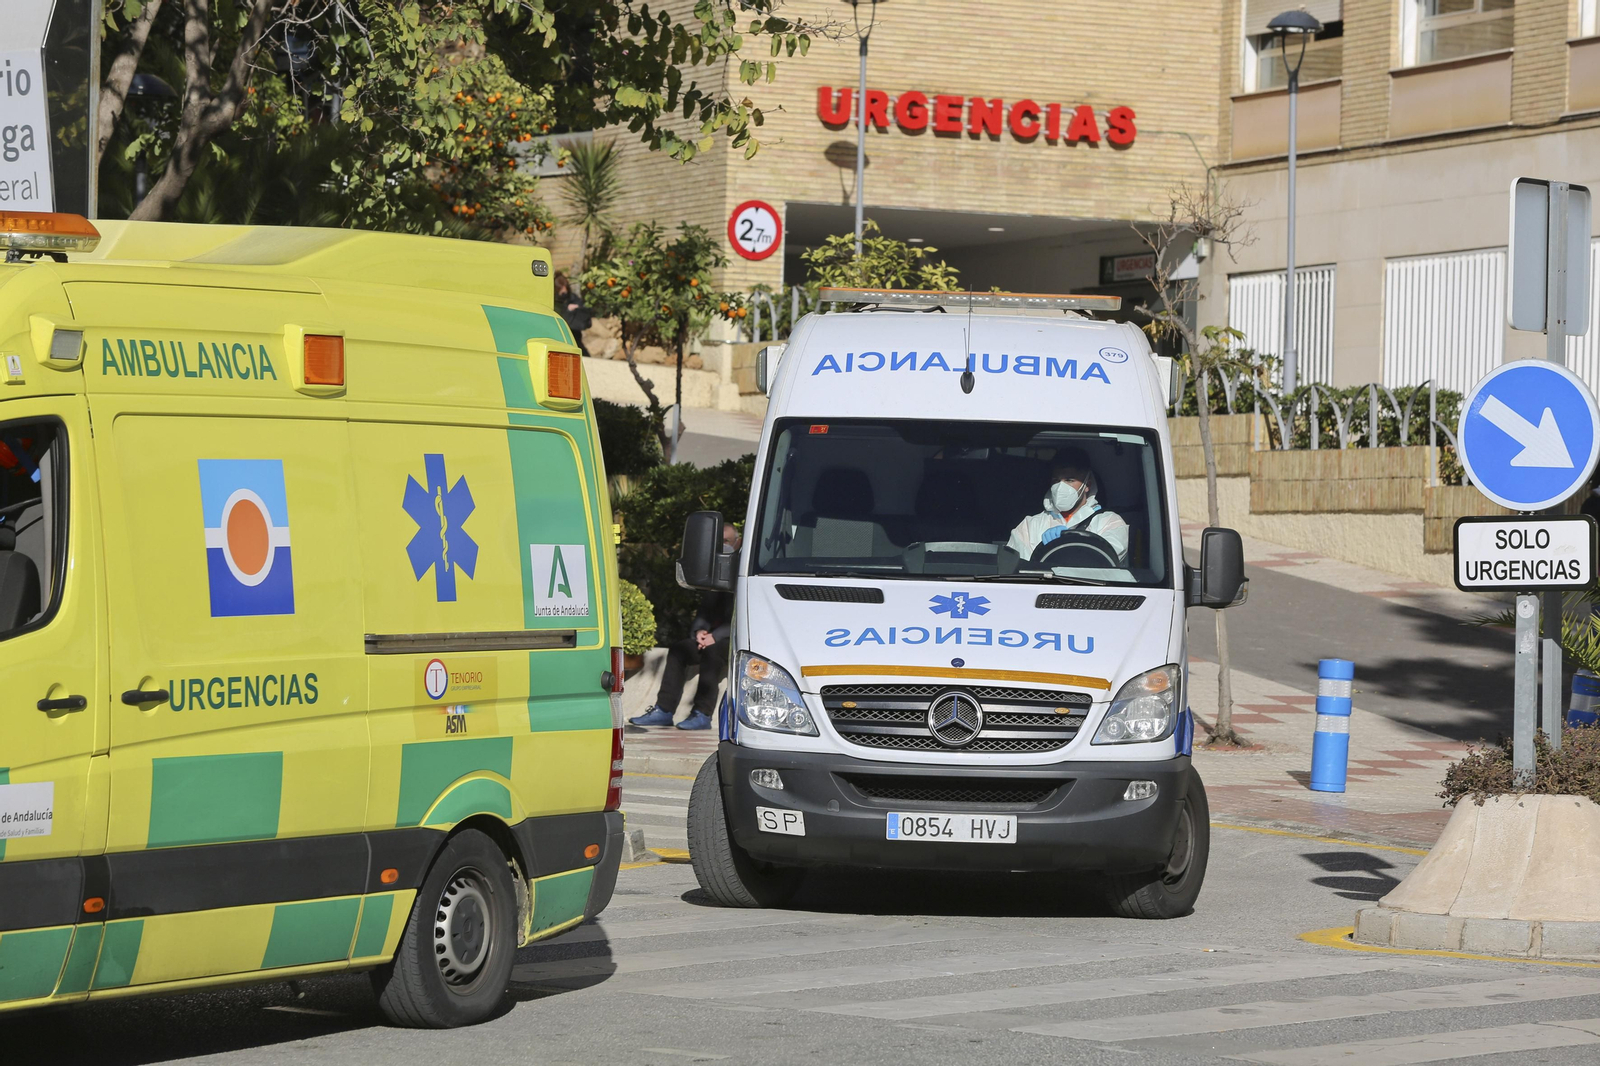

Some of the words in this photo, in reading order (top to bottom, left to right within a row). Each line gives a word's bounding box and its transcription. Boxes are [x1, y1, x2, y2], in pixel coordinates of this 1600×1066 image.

[0, 60, 31, 96] io
[817, 86, 1137, 145] URGENCIAS
[2, 124, 35, 162] ga
[0, 171, 39, 201] eral
[102, 338, 278, 381] AMBULANCIA
[1105, 351, 1124, 359] 379
[1495, 529, 1550, 550] SOLO
[1465, 559, 1581, 581] URGENCIAS
[535, 605, 552, 616] Junta
[552, 605, 560, 616] de
[560, 603, 589, 616] Andalucía
[450, 671, 483, 684] TENORIO
[169, 672, 319, 712] URGENCIAS
[445, 714, 467, 734] ASM
[1, 812, 12, 823] de
[13, 807, 53, 822] Andalucía
[902, 816, 954, 838] 0854
[970, 818, 1011, 839] HVJ
